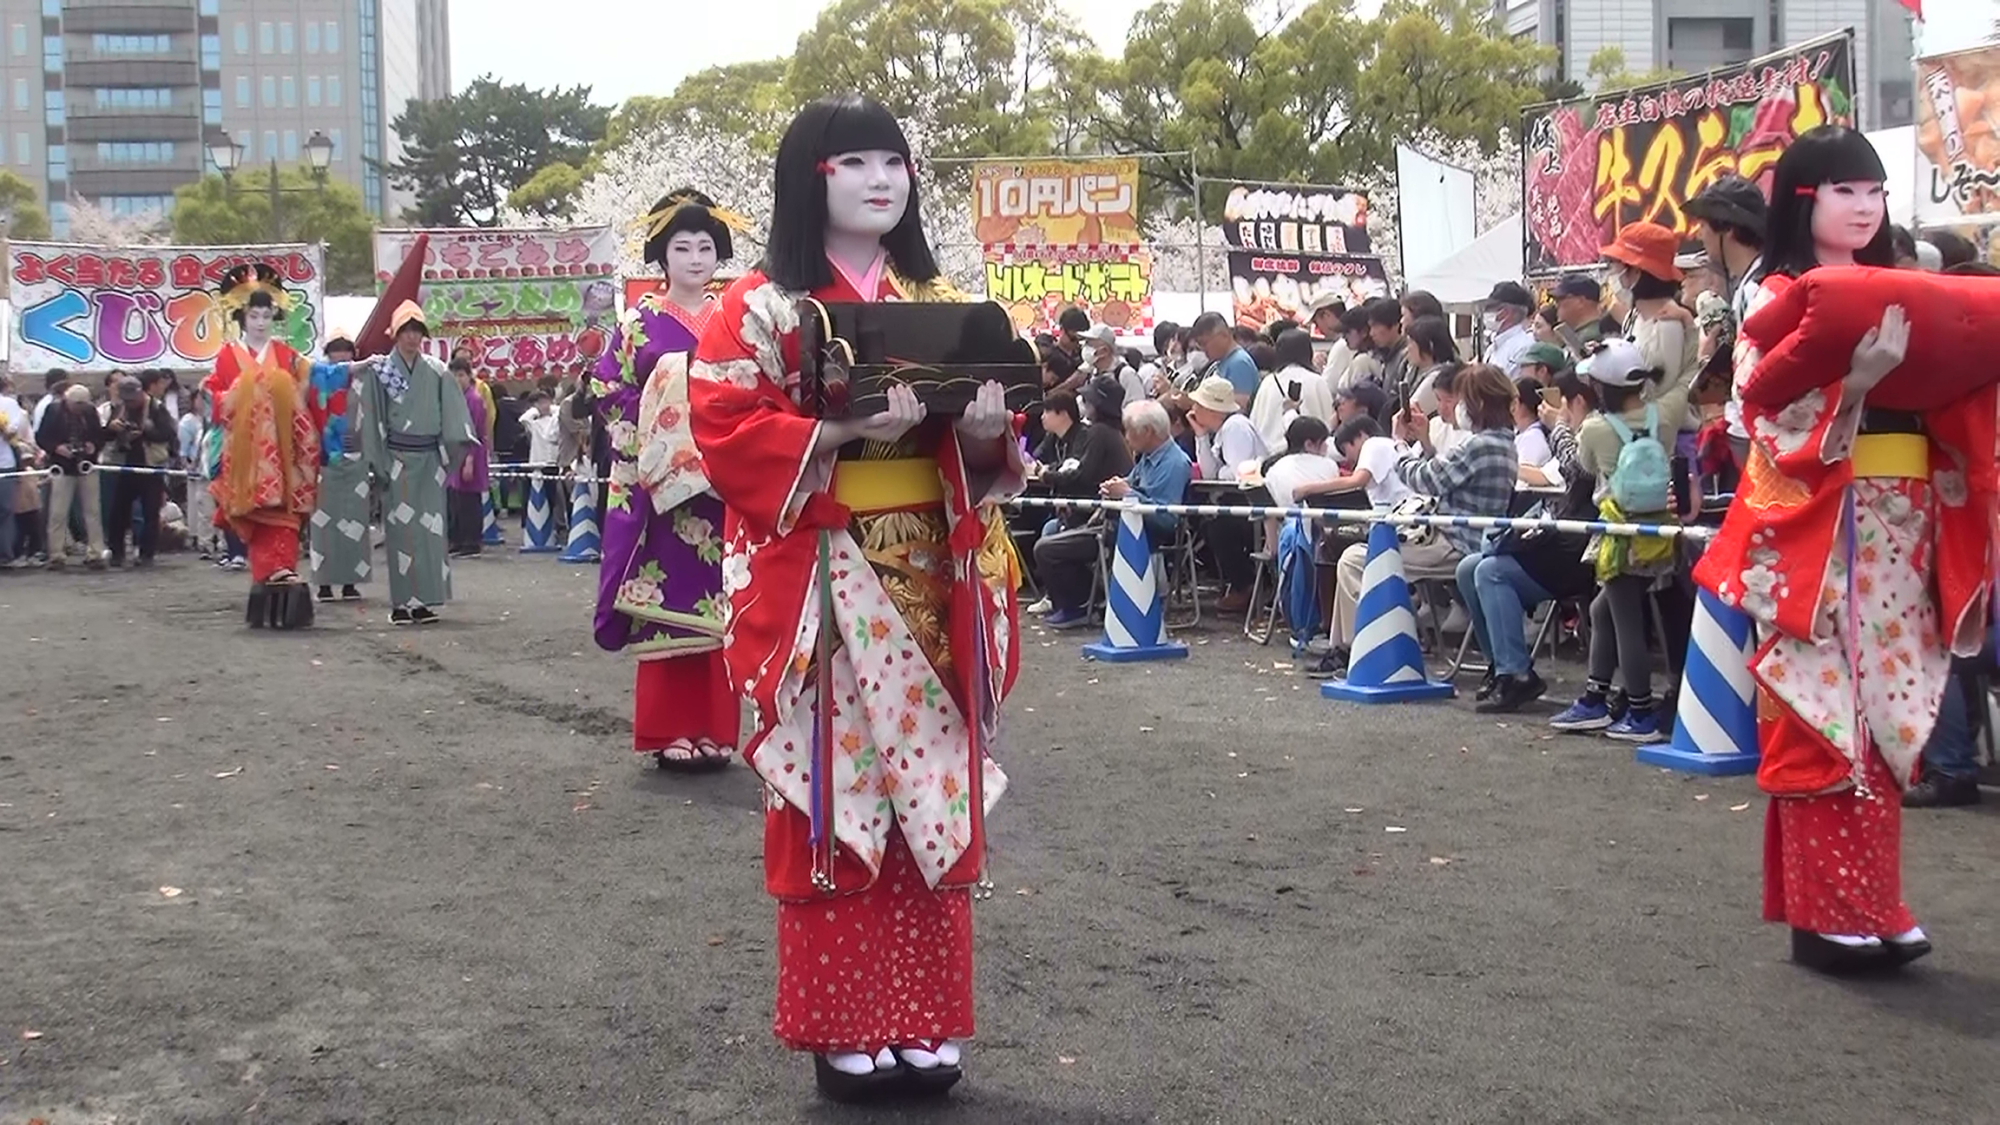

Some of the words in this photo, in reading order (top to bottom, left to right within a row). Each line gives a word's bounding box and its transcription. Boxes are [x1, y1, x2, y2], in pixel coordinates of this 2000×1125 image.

[1530, 115, 1563, 175] 極上
[1592, 82, 1826, 239] 牛ステー
[978, 175, 1132, 217] 10円パン
[12, 251, 166, 289] よく当たる
[986, 259, 1150, 303] トルネードポテト
[422, 281, 584, 319] ぶどうあめ
